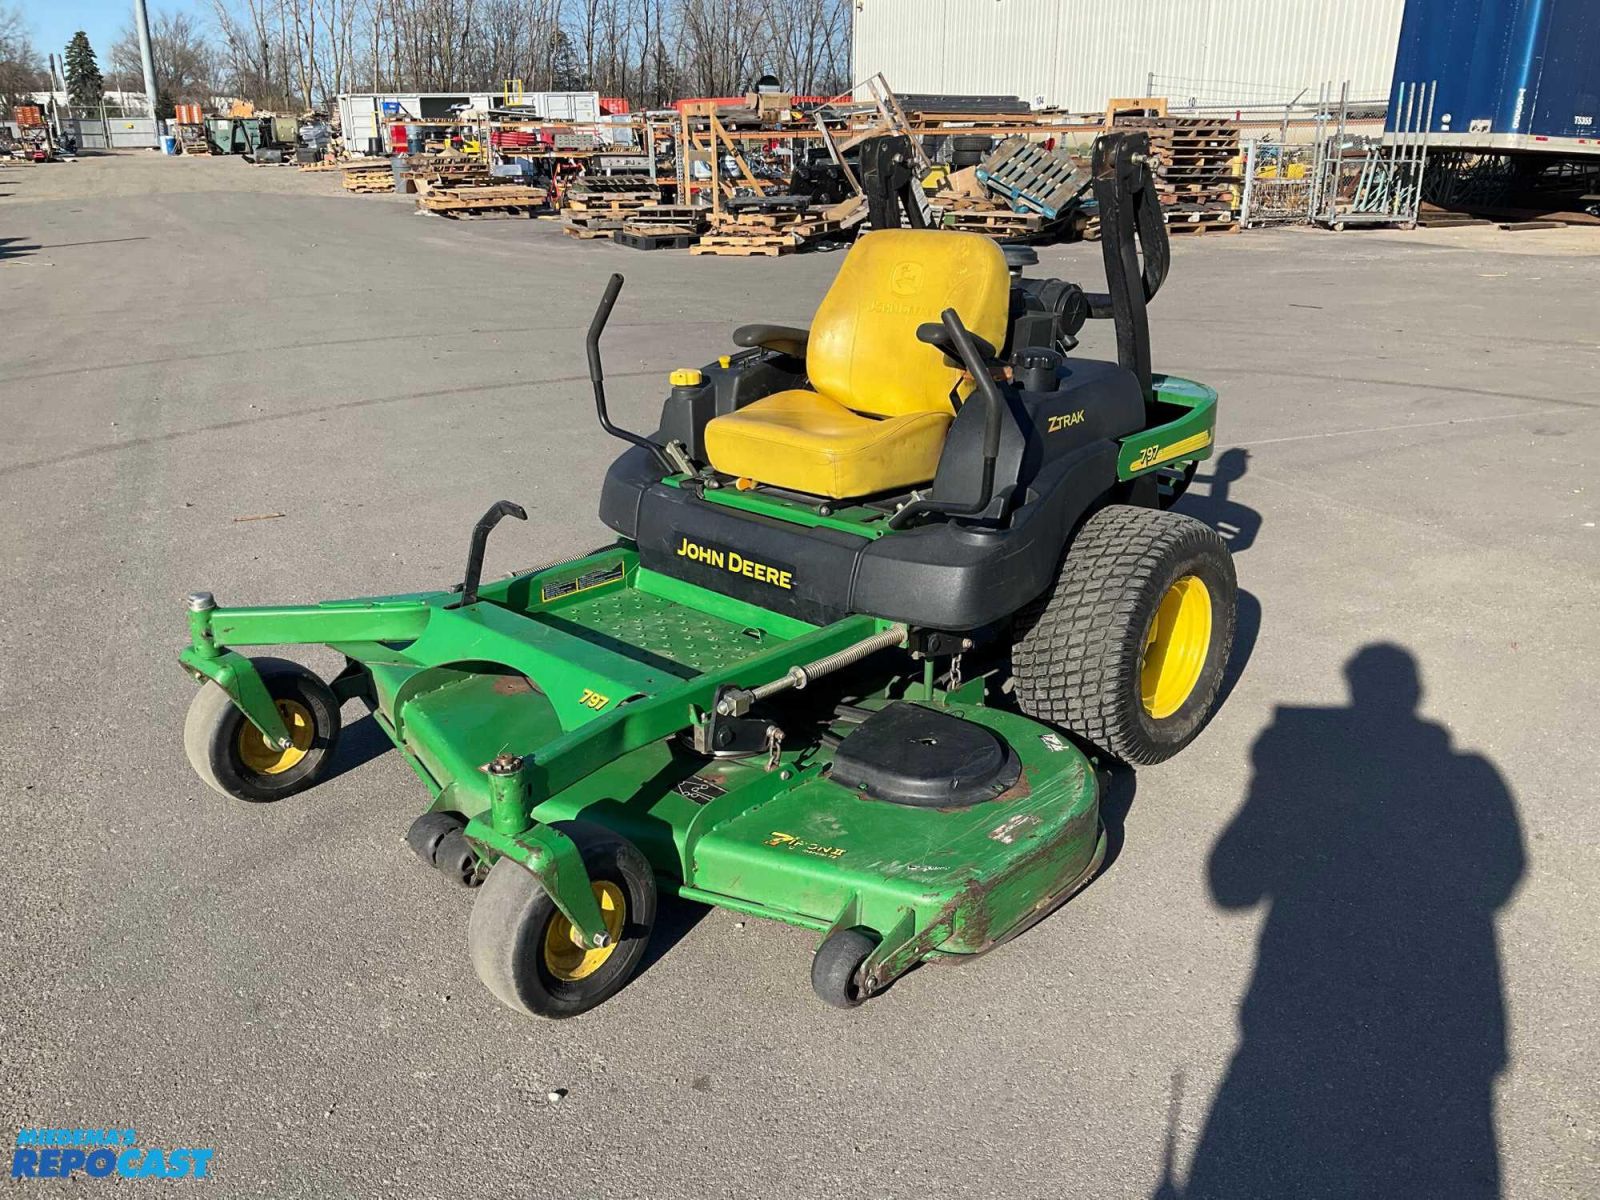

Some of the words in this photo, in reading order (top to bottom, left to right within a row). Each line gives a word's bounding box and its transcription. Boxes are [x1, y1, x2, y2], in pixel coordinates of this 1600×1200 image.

[1048, 409, 1085, 433] ZTRAK
[1140, 444, 1159, 465] 797
[677, 538, 724, 568] JOHN
[728, 552, 793, 589] DEERE
[578, 688, 610, 711] 797
